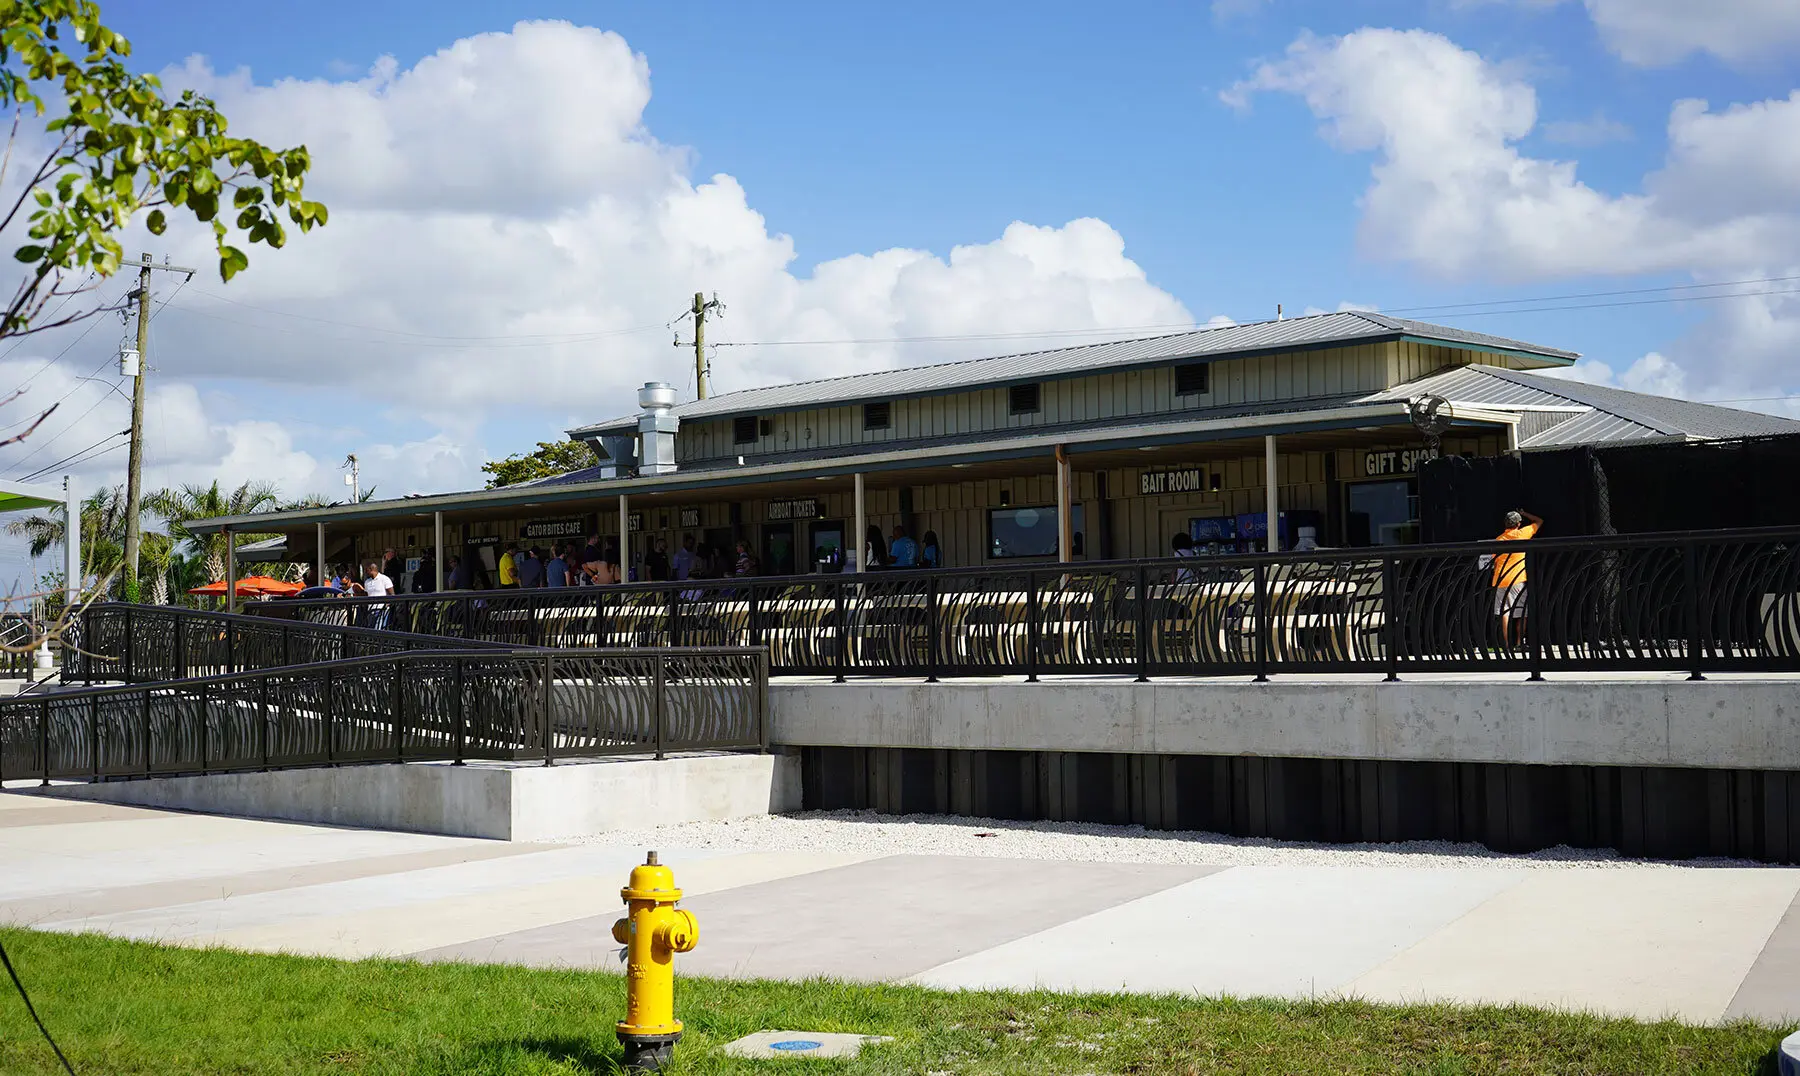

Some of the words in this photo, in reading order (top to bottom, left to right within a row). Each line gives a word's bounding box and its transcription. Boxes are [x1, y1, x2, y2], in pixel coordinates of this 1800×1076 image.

[1366, 451, 1396, 475] GIFT
[1141, 473, 1165, 493] BAIT
[1168, 470, 1200, 491] ROOM
[793, 499, 816, 518] TICKETS
[565, 521, 581, 534] CAFE
[626, 514, 640, 531] EST
